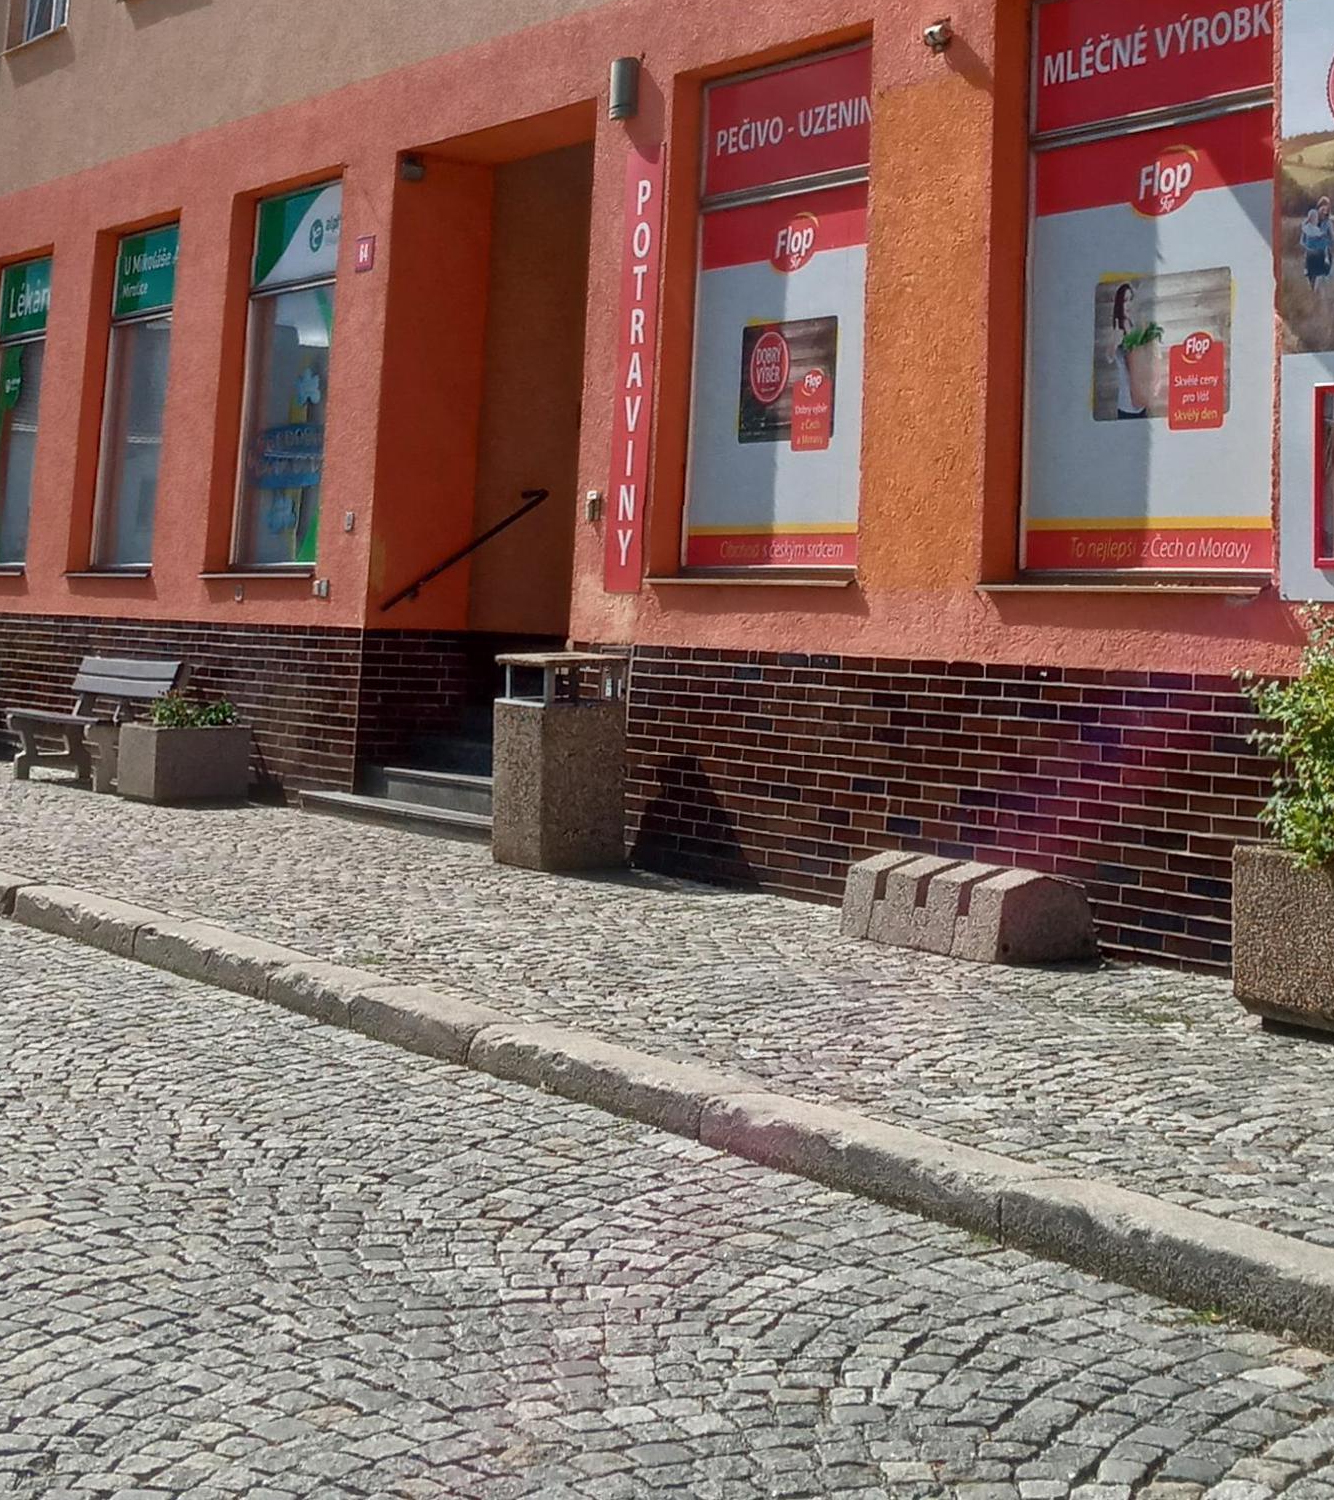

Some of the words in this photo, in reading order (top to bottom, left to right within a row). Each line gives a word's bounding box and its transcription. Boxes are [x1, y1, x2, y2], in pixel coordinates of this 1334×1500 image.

[1042, 24, 1148, 87] MLÉČNÉ
[716, 115, 784, 157] PEČIVO
[1138, 160, 1193, 201] Flop
[775, 225, 815, 260] Flop
[1185, 336, 1210, 355] Flop
[617, 179, 652, 567] POTRAVINY
[804, 374, 823, 390] Flop
[806, 540, 844, 559] srdcem
[1070, 536, 1086, 556] To
[1140, 541, 1150, 558] z
[1150, 533, 1184, 559] Čech
[1186, 541, 1197, 558] a
[1198, 536, 1252, 564] Moravy
